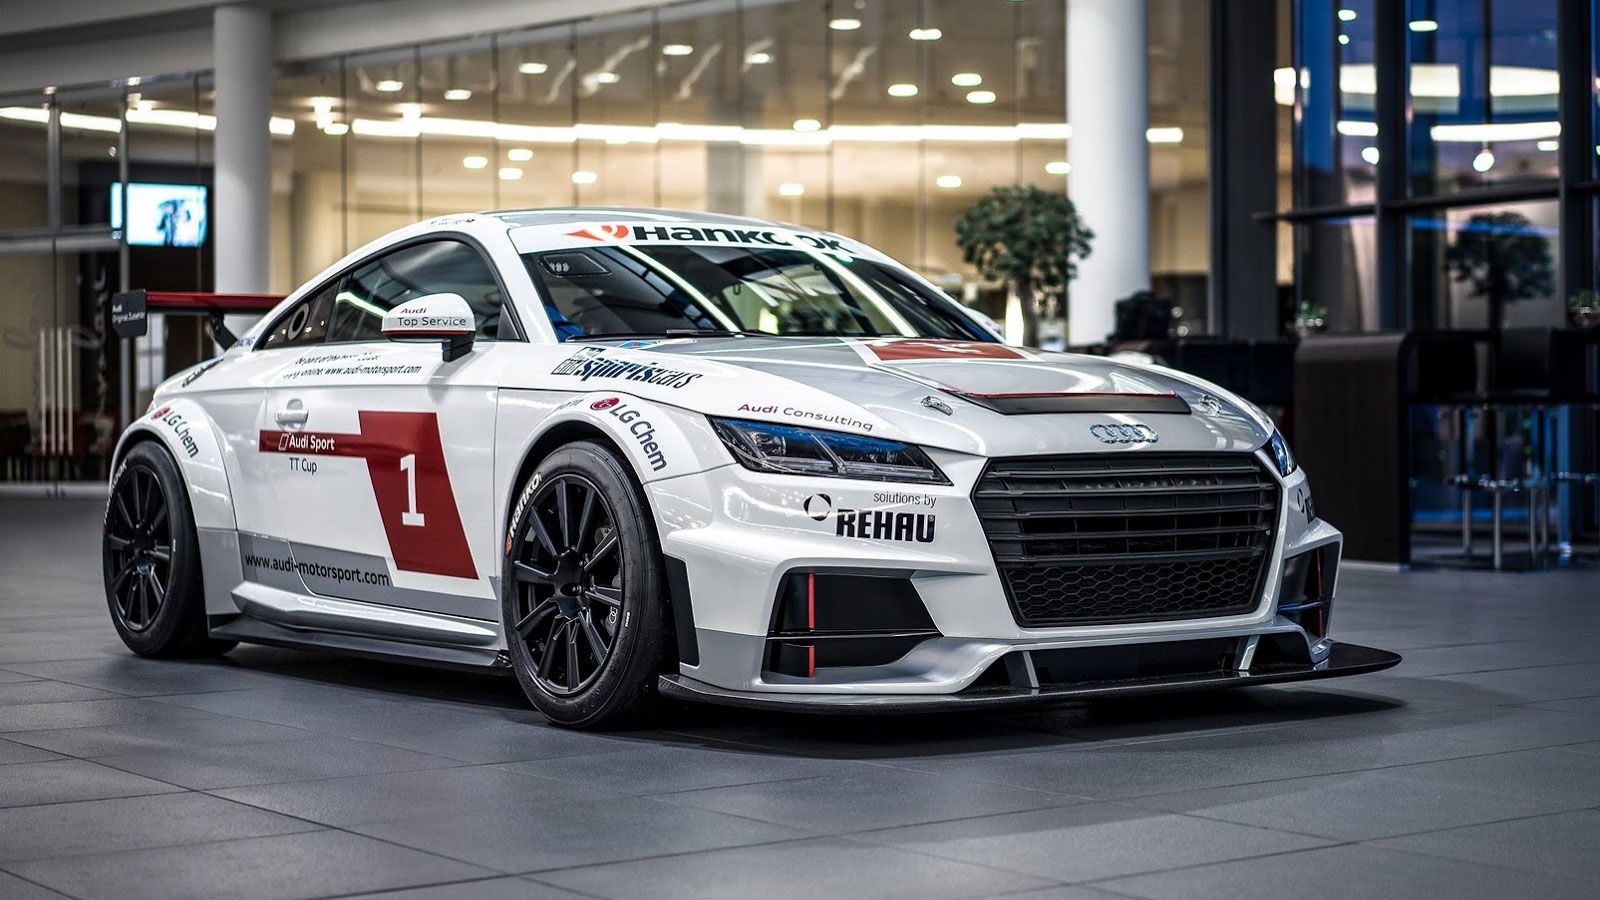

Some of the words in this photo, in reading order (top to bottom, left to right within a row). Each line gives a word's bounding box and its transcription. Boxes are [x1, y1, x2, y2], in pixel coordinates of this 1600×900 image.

[398, 317, 418, 328] Top
[421, 316, 466, 326] Service
[738, 403, 779, 414] Audi
[783, 407, 874, 433] Consulting
[162, 411, 182, 427] LG
[174, 421, 199, 458] Chem
[288, 434, 309, 449] Audi
[310, 435, 335, 452] Sport
[609, 404, 640, 424] LG
[630, 421, 667, 472] Chem
[289, 457, 299, 471] TT
[301, 460, 318, 475] Cup
[400, 453, 425, 527] 1
[873, 491, 921, 505] solutions
[924, 494, 937, 508] by
[836, 508, 936, 544] REHAU
[245, 554, 390, 587] www.audi-motorsport.com
